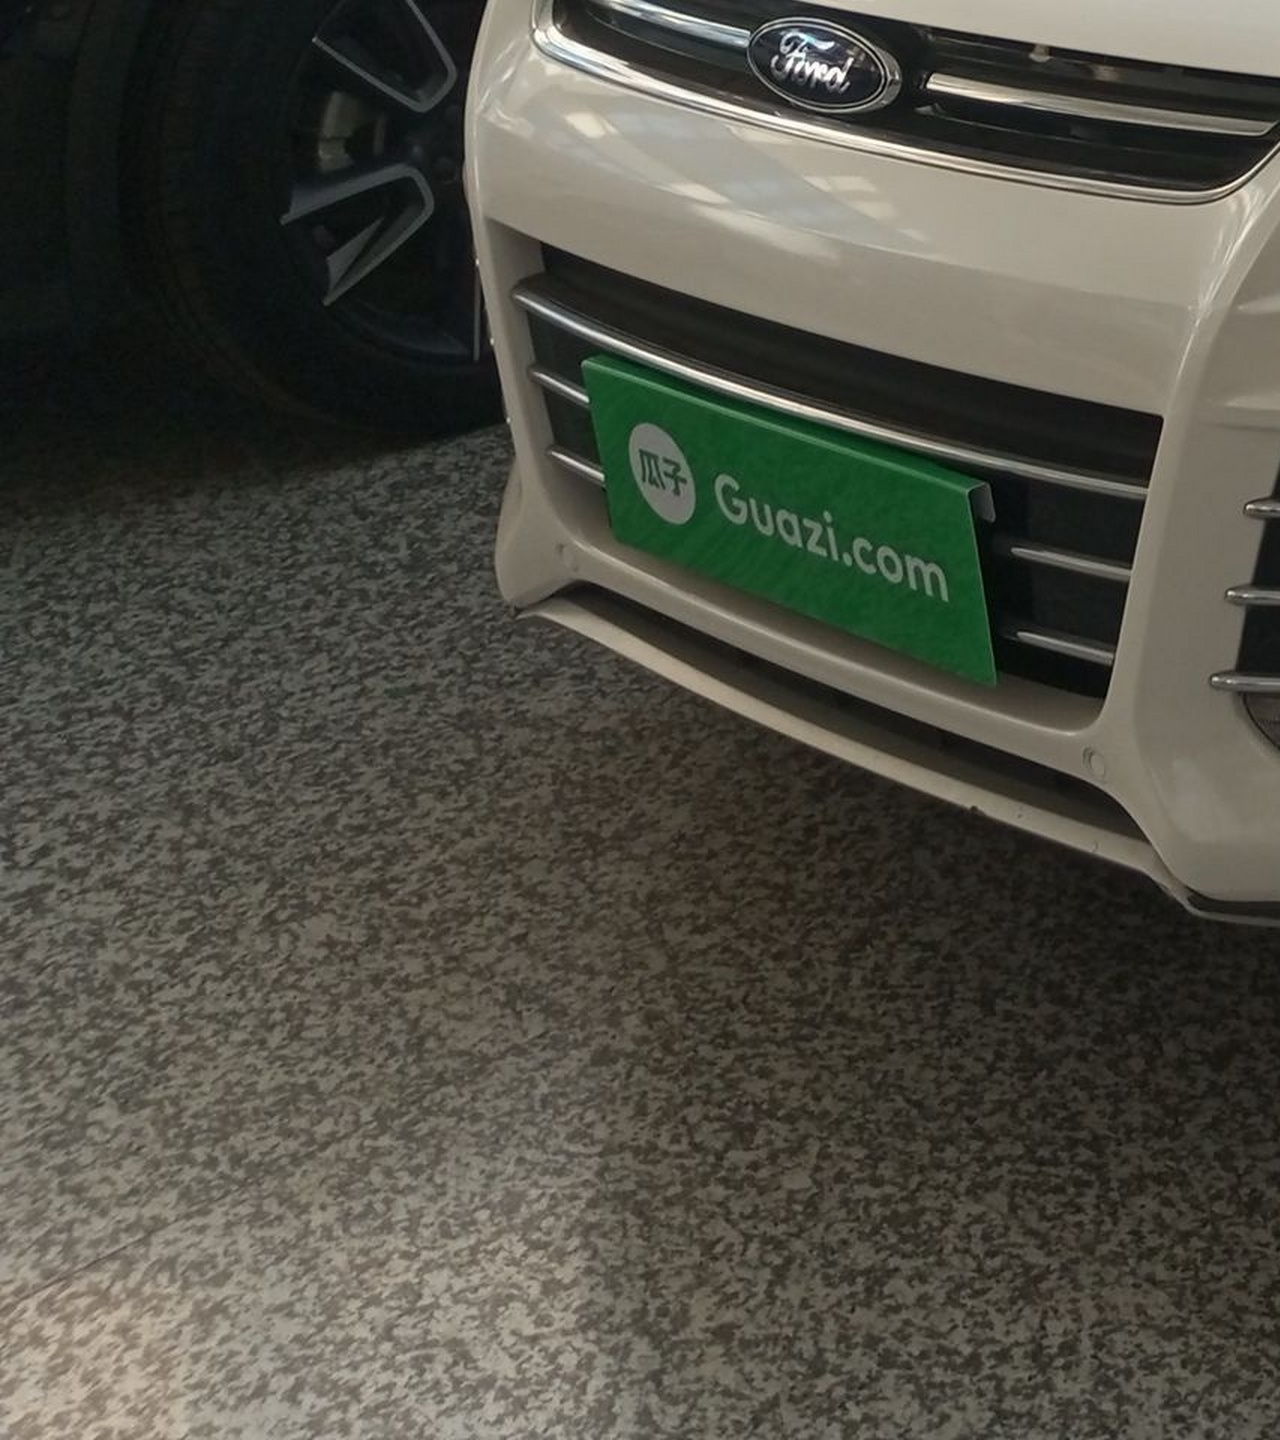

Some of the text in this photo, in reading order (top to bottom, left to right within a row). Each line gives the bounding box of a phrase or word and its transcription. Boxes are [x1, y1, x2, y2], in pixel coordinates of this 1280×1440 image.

[770, 28, 855, 94] Ford
[638, 449, 688, 496] 瓜子
[714, 473, 949, 603] Guazi.com
